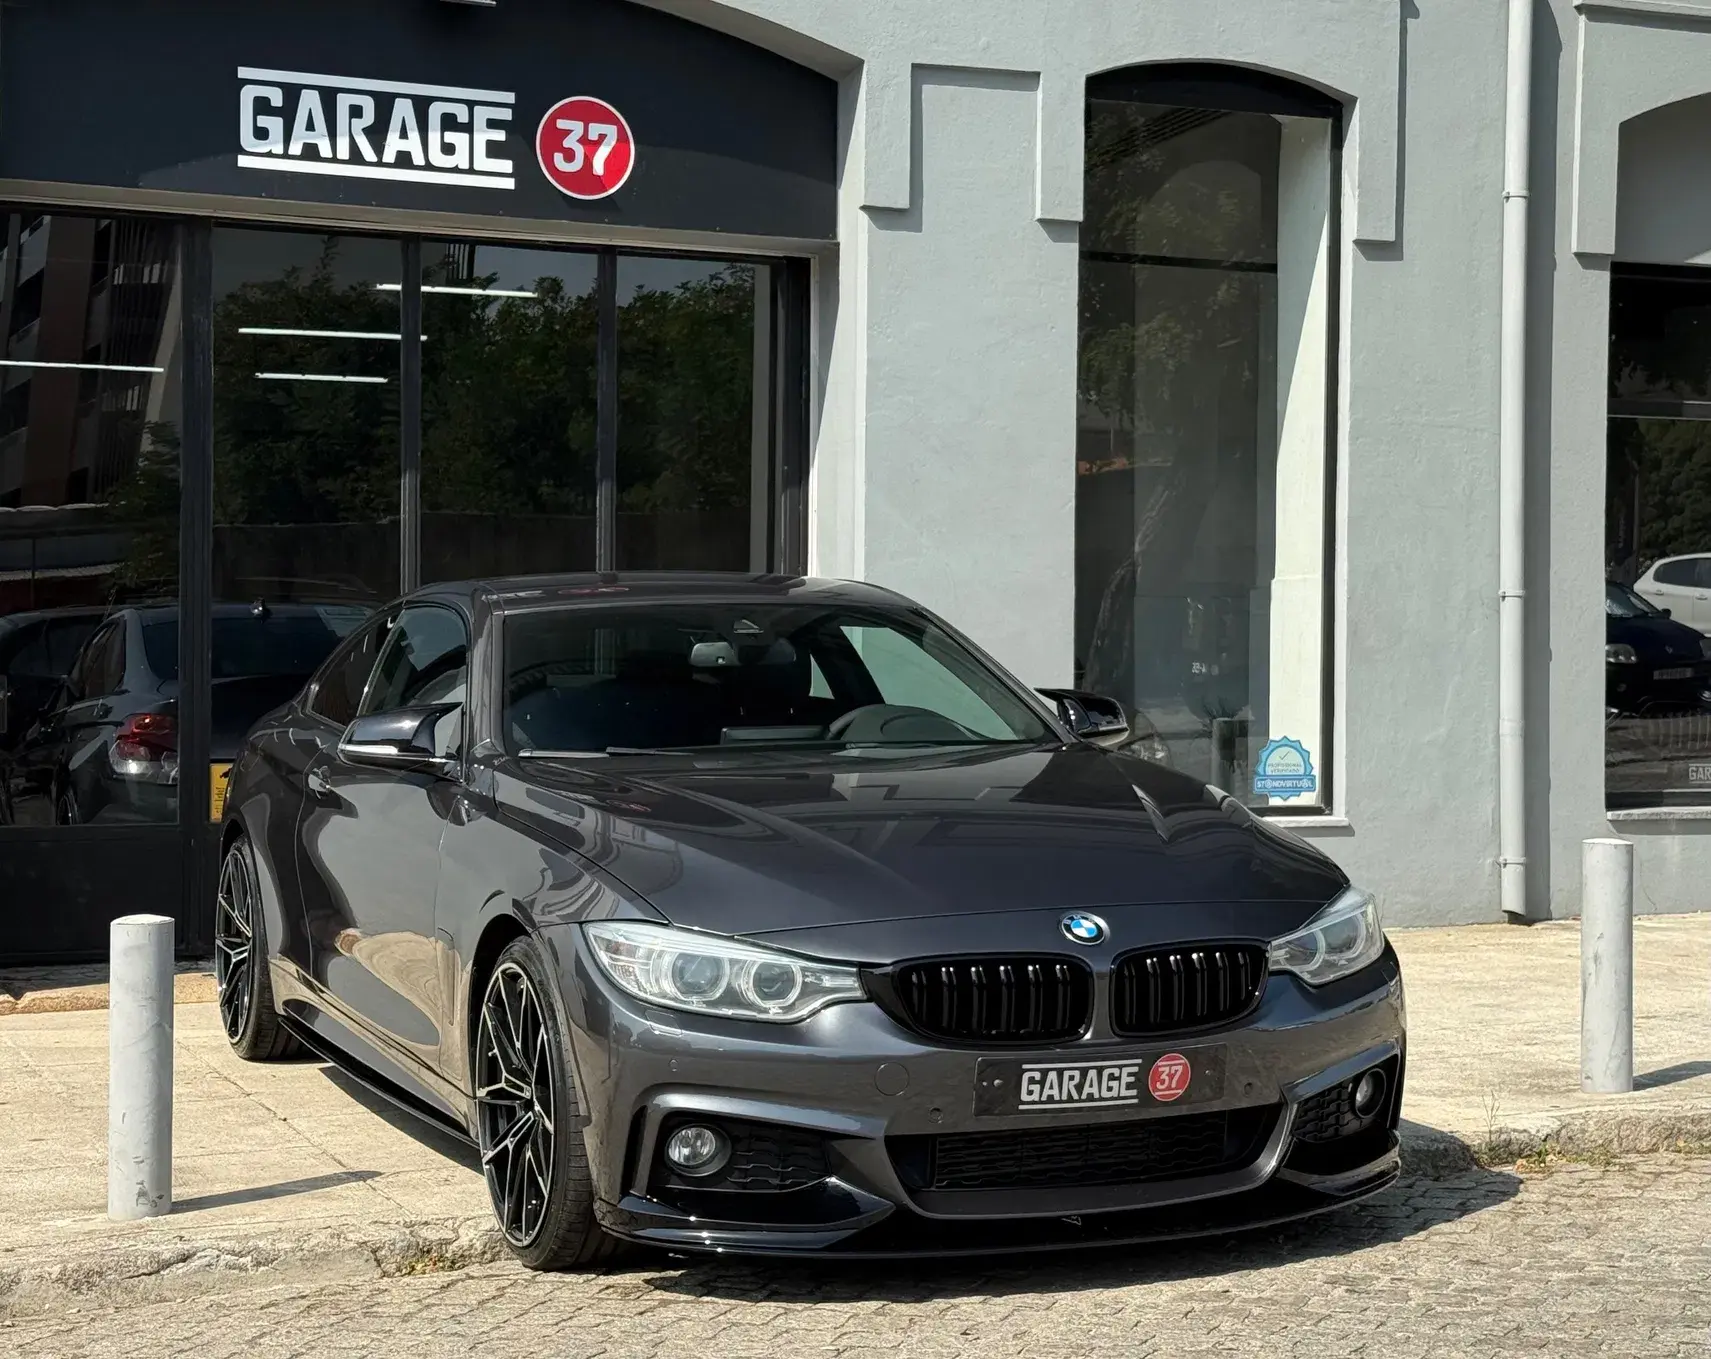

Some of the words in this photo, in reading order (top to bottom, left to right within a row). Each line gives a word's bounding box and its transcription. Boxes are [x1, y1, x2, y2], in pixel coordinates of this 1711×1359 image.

[239, 84, 513, 174] GARAGE
[553, 118, 618, 176] 37
[1020, 1066, 1139, 1102] GARAGE
[1156, 1065, 1183, 1089] 37
